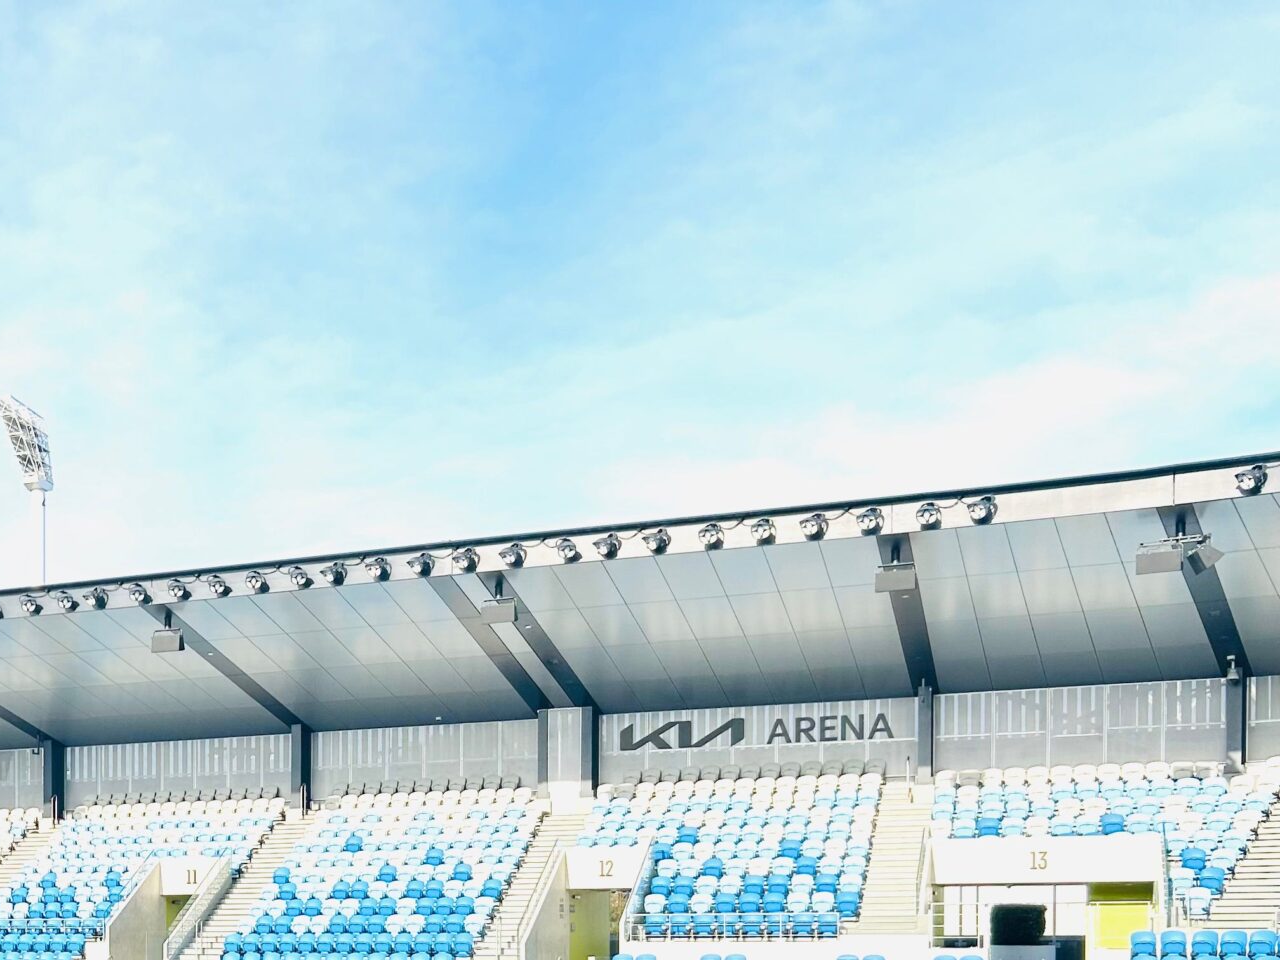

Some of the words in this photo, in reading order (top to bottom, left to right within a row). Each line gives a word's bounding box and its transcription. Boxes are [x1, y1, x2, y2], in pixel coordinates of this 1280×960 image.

[619, 717, 745, 751] KIA
[766, 712, 895, 745] ARENA
[599, 860, 614, 877] 12
[1029, 851, 1048, 870] 13
[186, 869, 198, 885] 11
